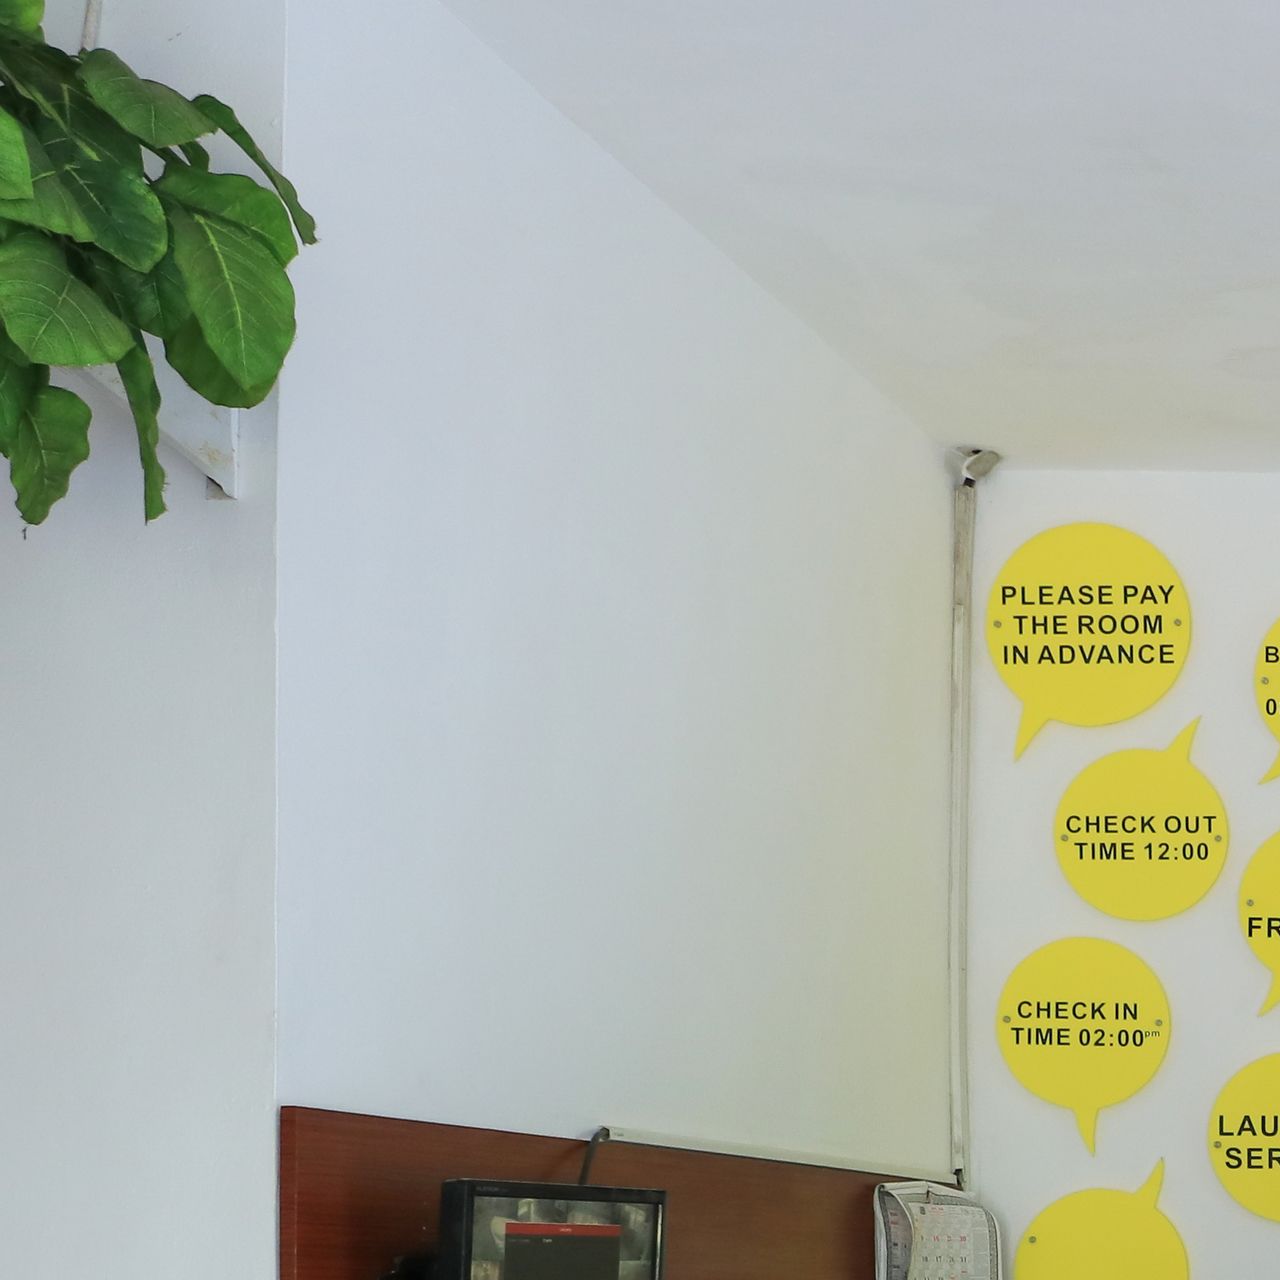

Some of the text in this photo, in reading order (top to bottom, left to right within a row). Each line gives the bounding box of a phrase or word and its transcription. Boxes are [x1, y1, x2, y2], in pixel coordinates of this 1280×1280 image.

[1001, 585, 1174, 605] PLEASE PAY
[1013, 614, 1163, 635] THE ROOM
[1003, 644, 1175, 665] IN ADVANCE
[1066, 815, 1217, 834] CHECK OUT
[1074, 842, 1209, 861] TIME 12:00
[1017, 1000, 1138, 1021] CHECK IN
[1010, 1027, 1070, 1046] TIME
